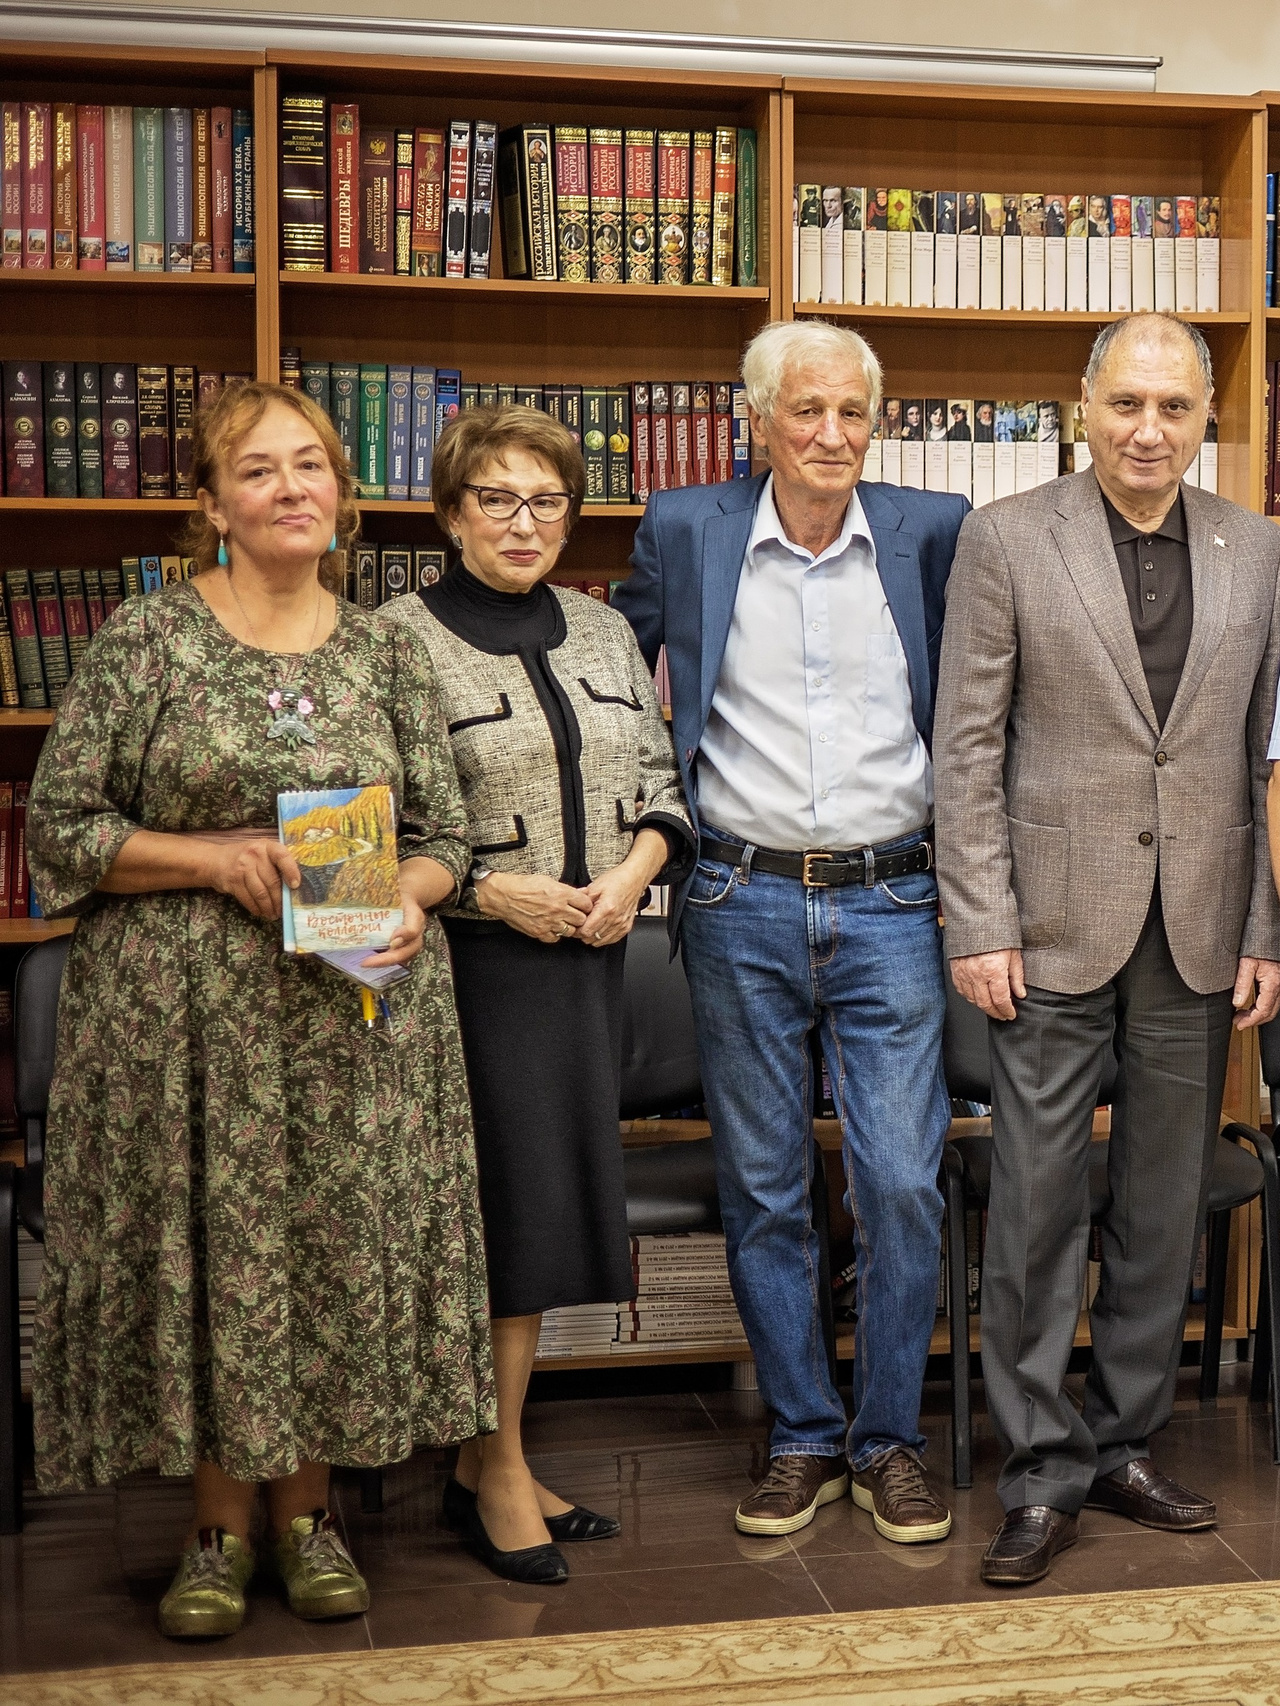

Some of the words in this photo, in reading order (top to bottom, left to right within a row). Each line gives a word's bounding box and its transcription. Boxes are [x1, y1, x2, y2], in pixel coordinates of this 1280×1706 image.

[144, 114, 155, 141] ДЕТЕЙ
[173, 115, 184, 142] ДЕТЕЙ
[196, 115, 206, 142] ДЕТЕЙ
[111, 143, 120, 160] ДЛЯ
[146, 144, 154, 162] ДЛЯ
[175, 145, 184, 163] ДЛЯ
[197, 145, 206, 163] ДЛЯ
[235, 143, 243, 168] ВЕКА.
[243, 136, 252, 172] СТРАНЫ
[337, 148, 345, 175] русской
[569, 145, 578, 192] ИСТОРИЯ
[600, 149, 608, 192] ИСТОРИЯ
[608, 151, 616, 190] РОССИИ
[529, 162, 542, 209] ИСТОРИЯ
[635, 152, 644, 191] РУССКАЯ
[643, 151, 651, 192] ИСТОРИЯ
[12, 189, 20, 214] РОССИИ
[64, 194, 72, 226] ДРЕВНЕГО
[111, 164, 121, 236] ЭНЦИКЛОПЕДИЯ
[145, 165, 156, 237] ЭНЦИКЛОПЕДИЯ
[175, 166, 185, 237] ЭНЦИКЛОПЕДИЯ
[198, 166, 207, 237] ЭНЦИКЛОПЕДИЯ
[234, 186, 243, 227] ИСТОРИЯ
[244, 174, 252, 234] ЗАРУБЕЖНЫЕ
[338, 179, 353, 249] ШЕДЕВРЫ
[373, 177, 381, 246] КОНСТИТУЦИИ
[380, 177, 389, 213] Федерации
[416, 183, 425, 230] КУЛЬТУРЫ
[425, 183, 433, 231] МИРОВОЙ
[433, 184, 441, 231] СОКРОВИЩА
[380, 214, 388, 252] Российской
[531, 209, 547, 276] РОССИЙСКАЯ
[637, 418, 649, 461] ПИКУЛЬ
[655, 418, 667, 461] ПИКУЛЬ
[676, 418, 688, 461] ПИКУЛЬ
[697, 417, 708, 460] ПИКУЛЬ
[717, 418, 728, 461] ПИКУЛЬ
[586, 472, 595, 496] ДЕЛО
[595, 463, 603, 494] СЛОВО
[611, 472, 620, 495] ДЕЛО
[619, 463, 627, 492] СЛОВО
[306, 911, 391, 929] Восточные
[318, 923, 382, 940] коллажи
